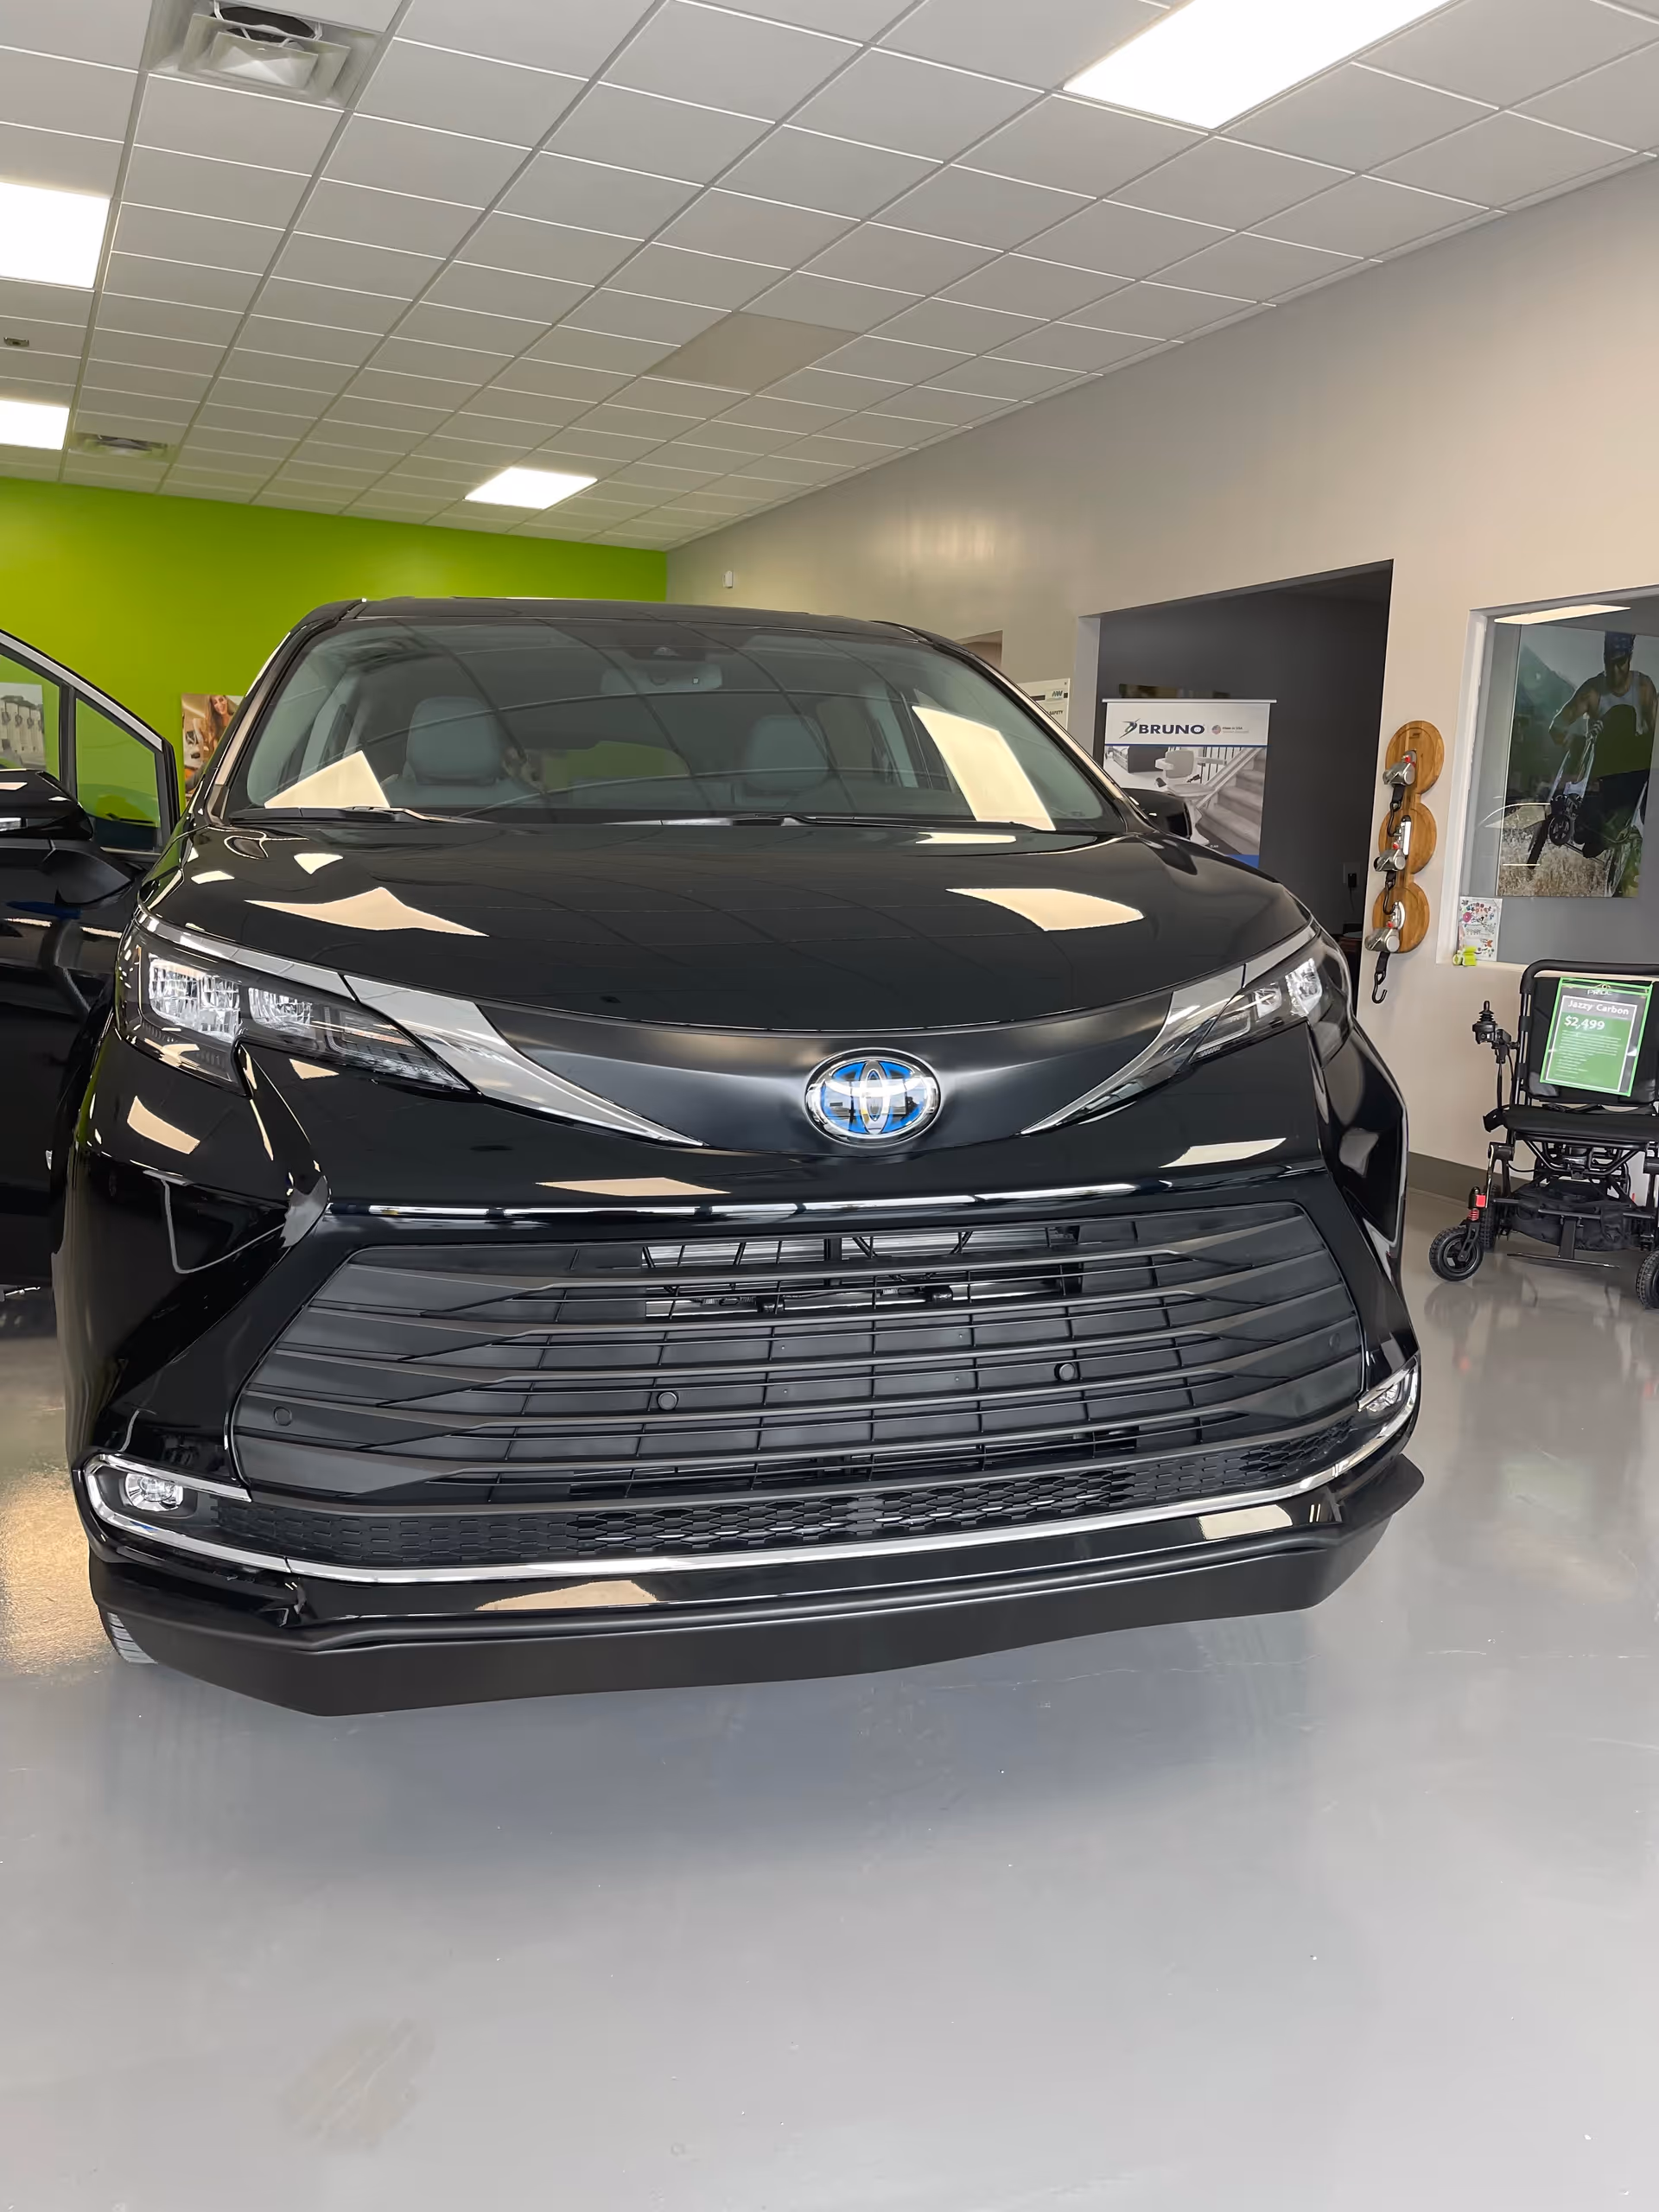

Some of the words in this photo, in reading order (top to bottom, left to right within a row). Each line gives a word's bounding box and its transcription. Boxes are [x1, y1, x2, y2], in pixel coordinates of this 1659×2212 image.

[1139, 724, 1205, 734] BRUNO
[1567, 1000, 1593, 1012] Jazzy
[1596, 1004, 1630, 1015] Carbon
[1564, 1015, 1605, 1031] $2,499
